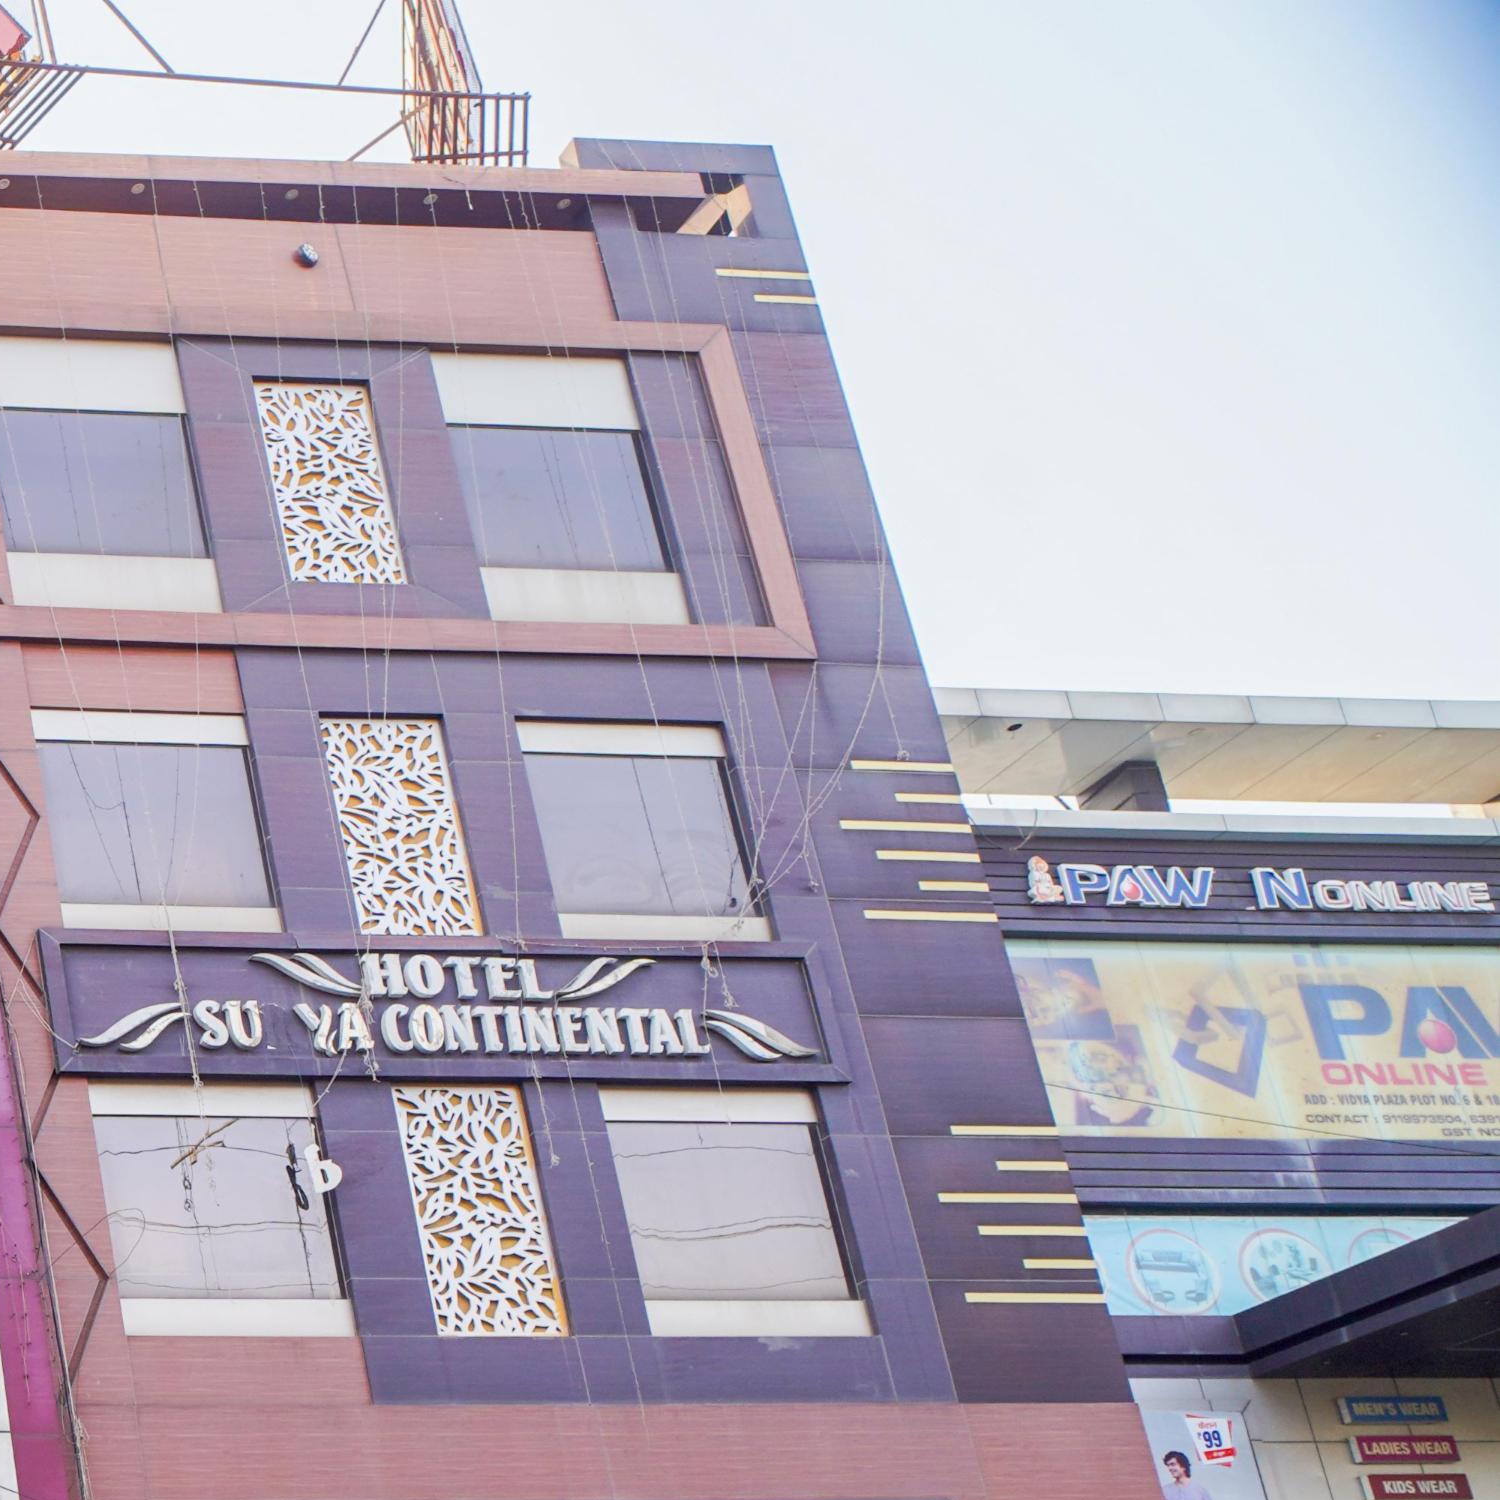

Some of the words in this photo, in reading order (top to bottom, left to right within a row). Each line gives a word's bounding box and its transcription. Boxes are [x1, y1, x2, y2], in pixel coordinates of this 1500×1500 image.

[1057, 863, 1214, 908] PAW
[362, 953, 553, 1001] HOTEL
[381, 1005, 712, 1057] CONTINENTAL
[1321, 1063, 1488, 1087] ONLINE
[1305, 1094, 1327, 1105] ADD
[1374, 1094, 1407, 1105] PLAZA
[1411, 1095, 1436, 1105] PLOT
[1306, 1114, 1368, 1124] CONTACT
[1442, 1128, 1472, 1137] GST
[1352, 1401, 1394, 1416] MEN'S
[1397, 1402, 1440, 1416] WEAR
[1362, 1441, 1409, 1455] LADIES
[1412, 1441, 1453, 1456] WEAR
[1382, 1480, 1415, 1494] KIDS
[1417, 1480, 1458, 1494] WEAR
